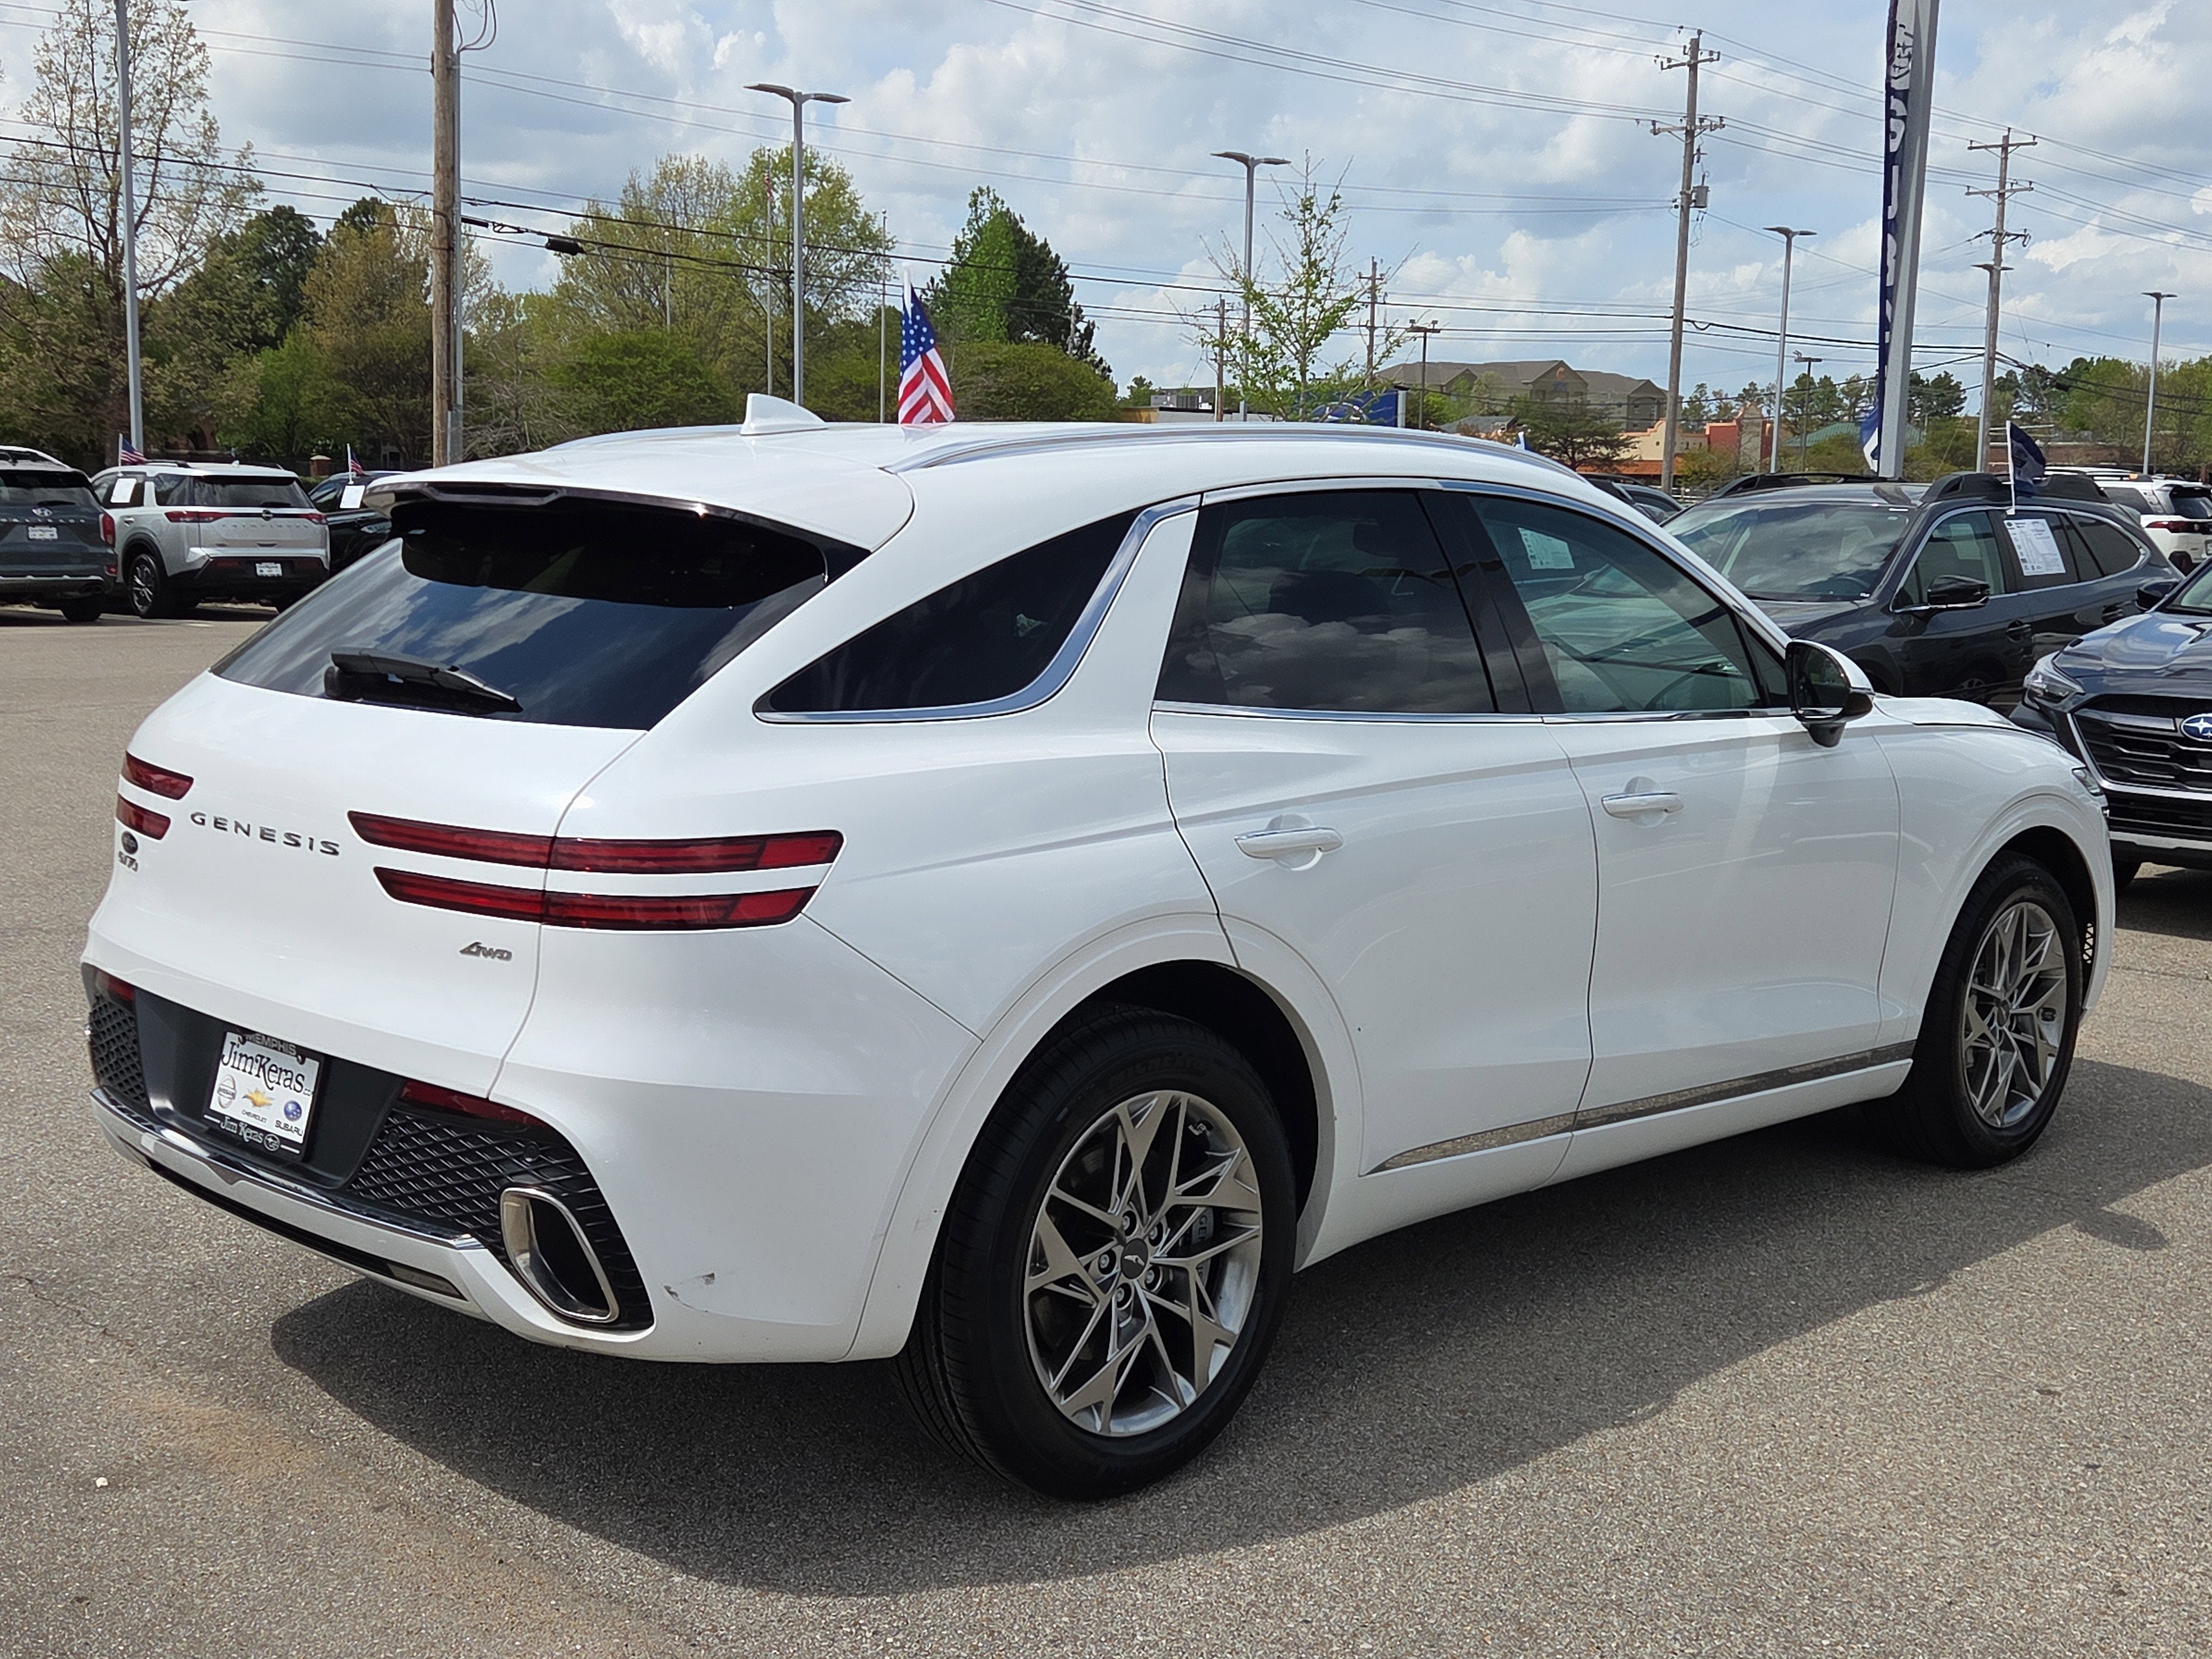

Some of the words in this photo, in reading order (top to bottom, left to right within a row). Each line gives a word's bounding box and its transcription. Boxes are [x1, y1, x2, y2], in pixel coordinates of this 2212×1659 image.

[190, 812, 340, 856] GENESIS
[245, 1033, 297, 1057] MEMPHIS
[220, 1116, 237, 1135] Jim
[239, 1121, 264, 1143] Keras
[274, 1119, 304, 1137] SUBARU
